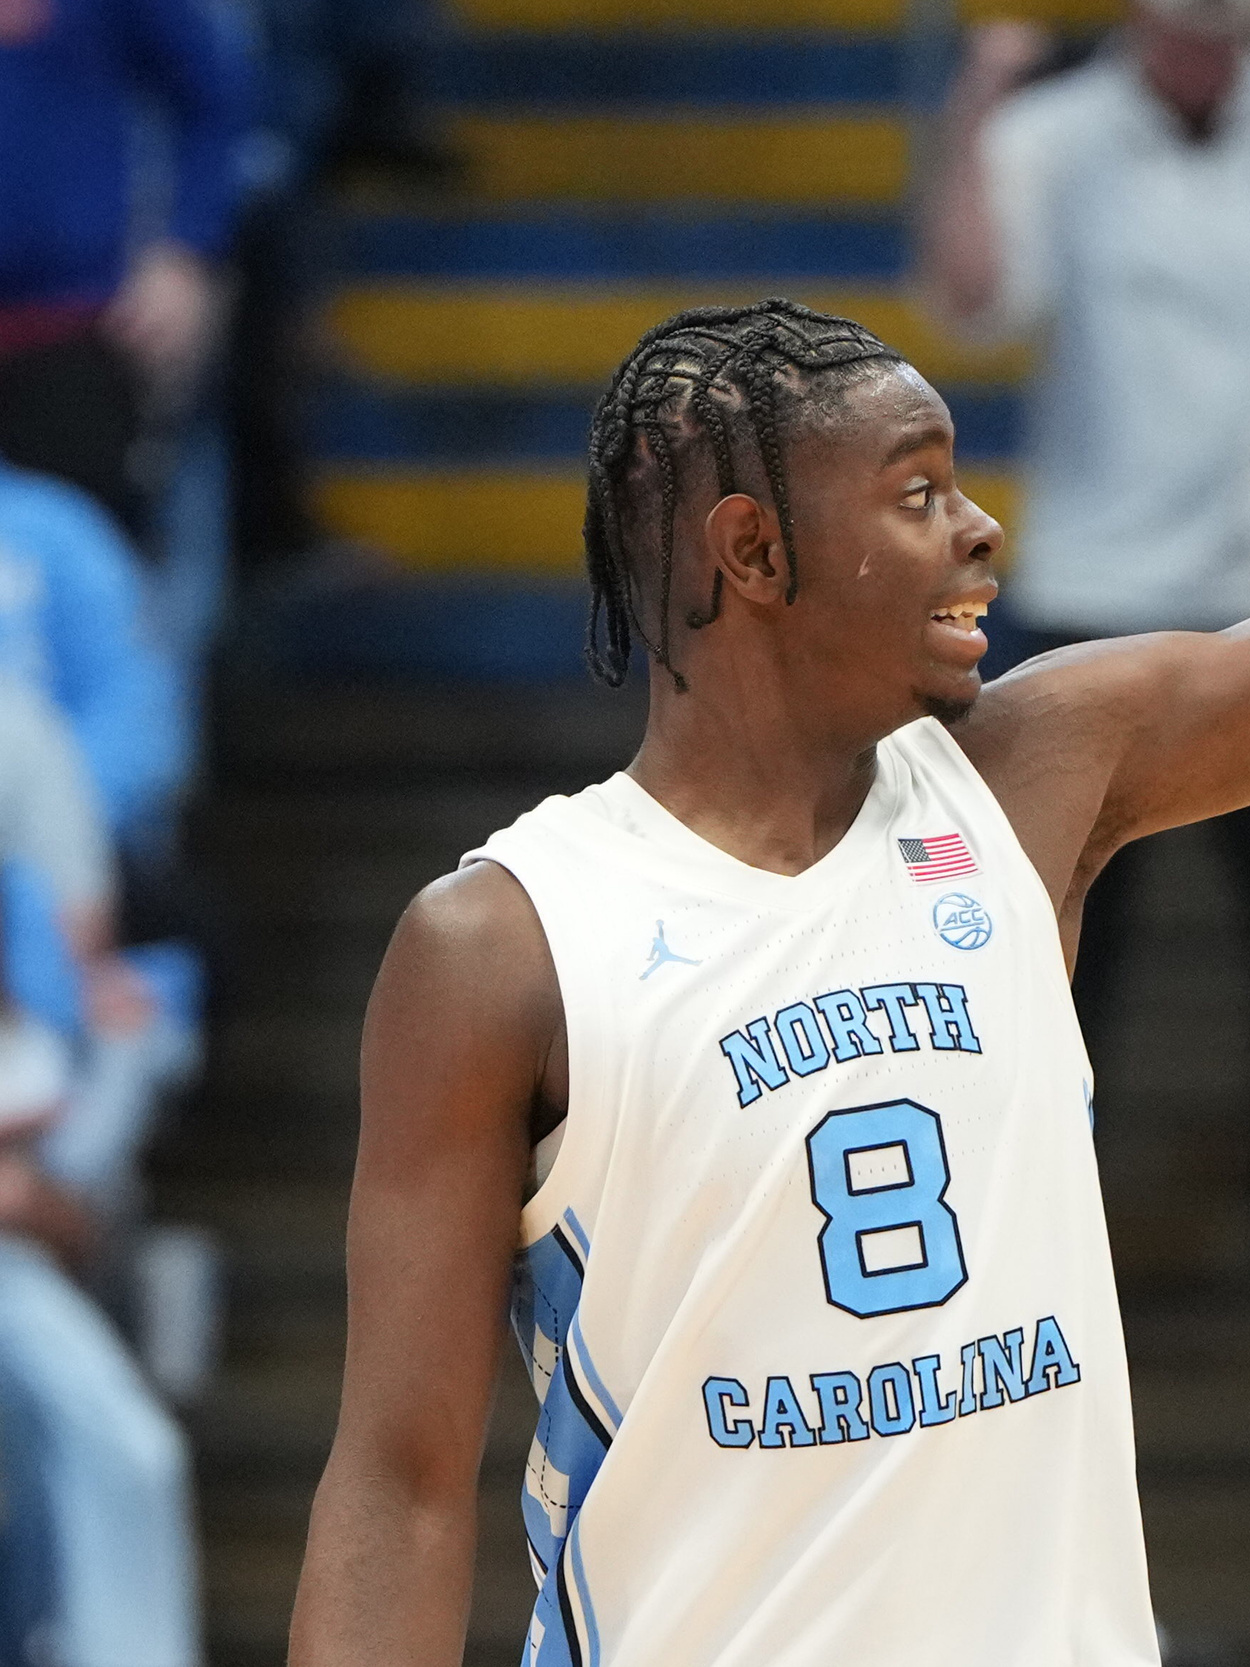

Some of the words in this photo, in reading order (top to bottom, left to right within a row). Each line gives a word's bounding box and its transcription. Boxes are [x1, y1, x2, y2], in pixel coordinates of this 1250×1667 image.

[942, 908, 985, 926] ACC
[719, 982, 982, 1109] NORTH
[805, 1098, 969, 1319] 8
[701, 1315, 1081, 1449] CAROLINA
